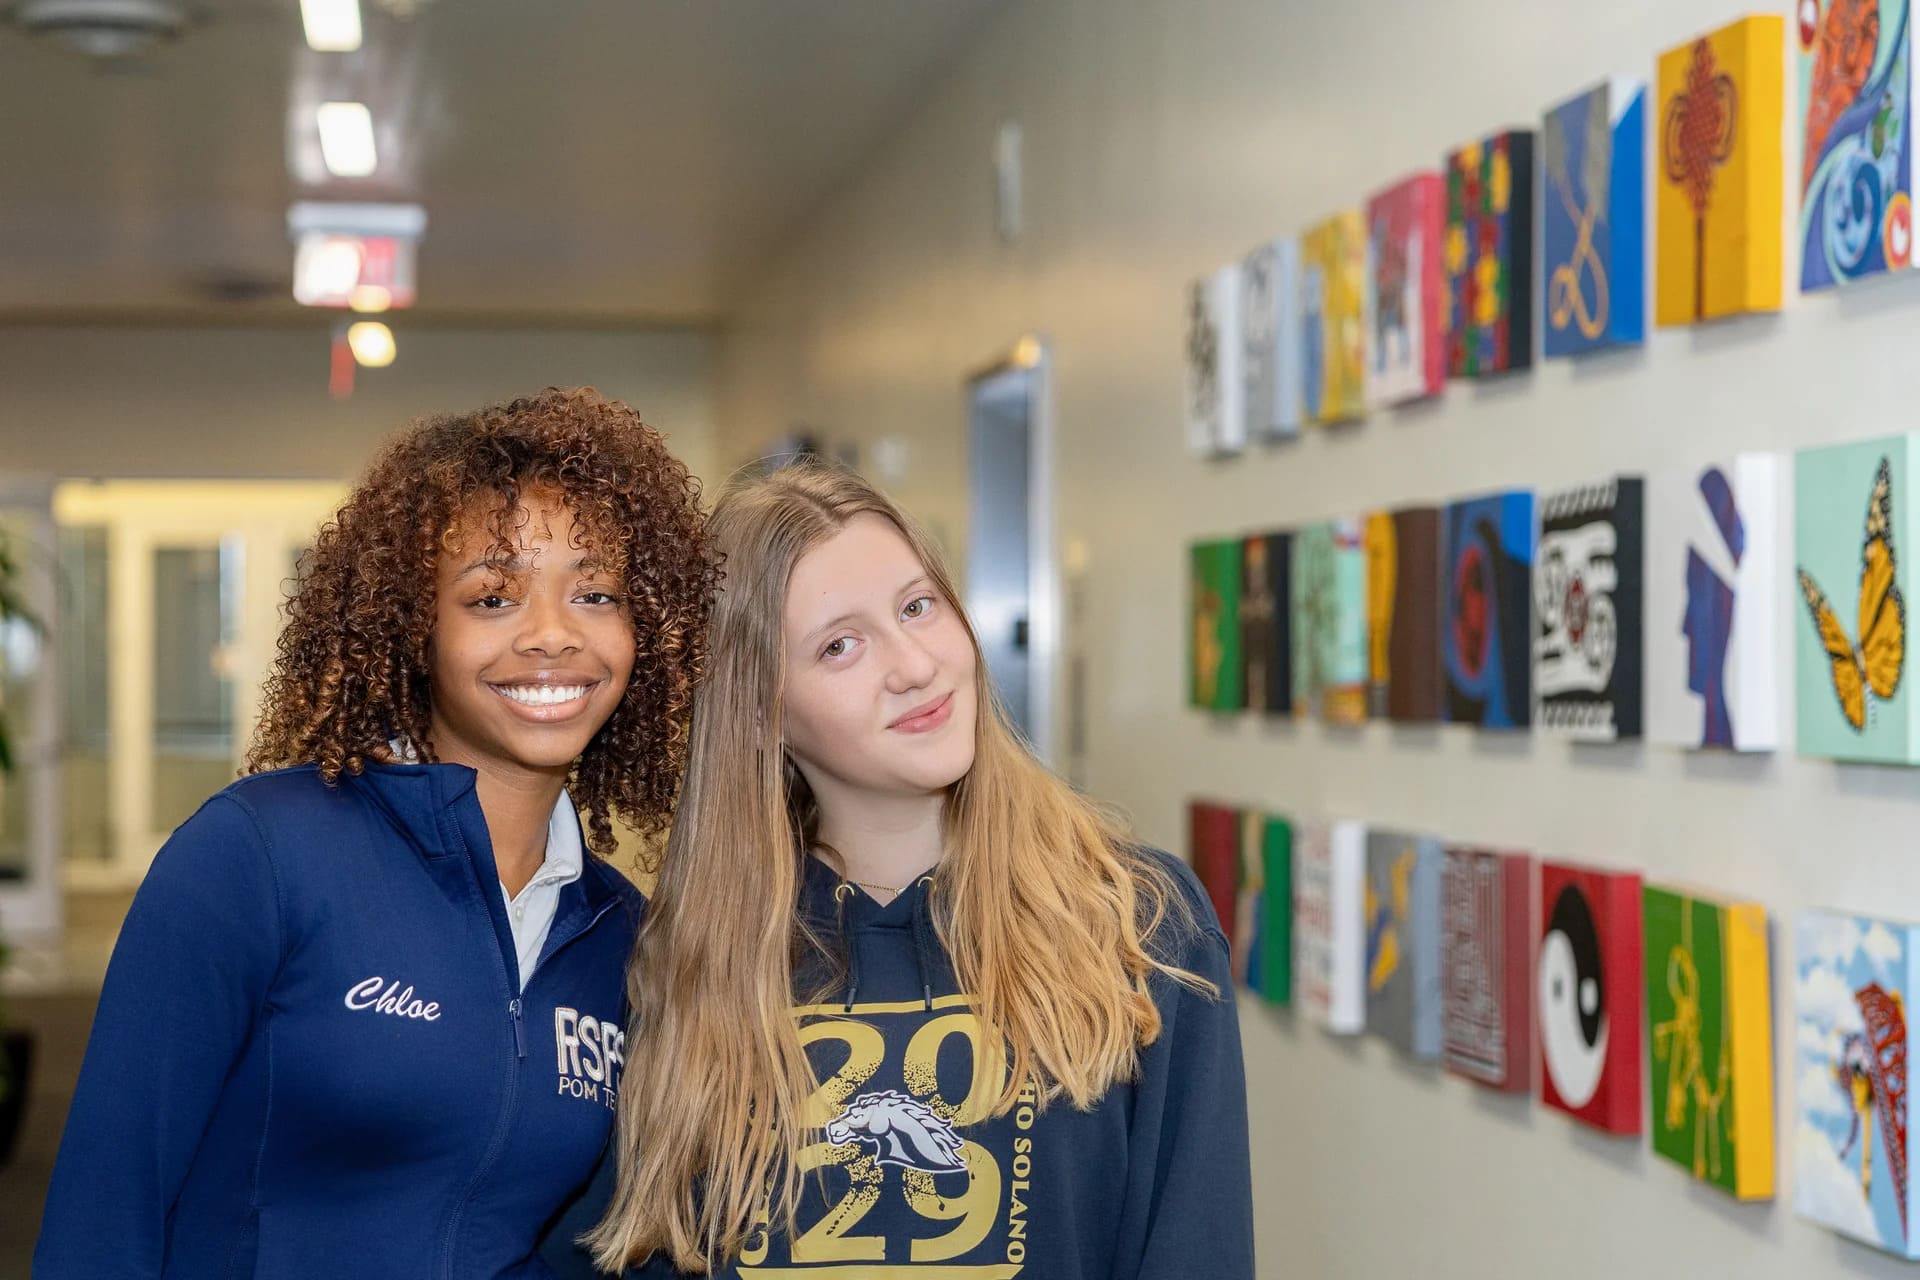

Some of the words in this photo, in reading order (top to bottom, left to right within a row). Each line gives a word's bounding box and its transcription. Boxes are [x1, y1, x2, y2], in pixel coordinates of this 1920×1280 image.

[344, 976, 441, 1021] Chloe
[558, 1076, 598, 1102] POM
[797, 1013, 1007, 1129] 20
[791, 1139, 1002, 1264] 29
[1006, 1136, 1032, 1265] SOLANO
